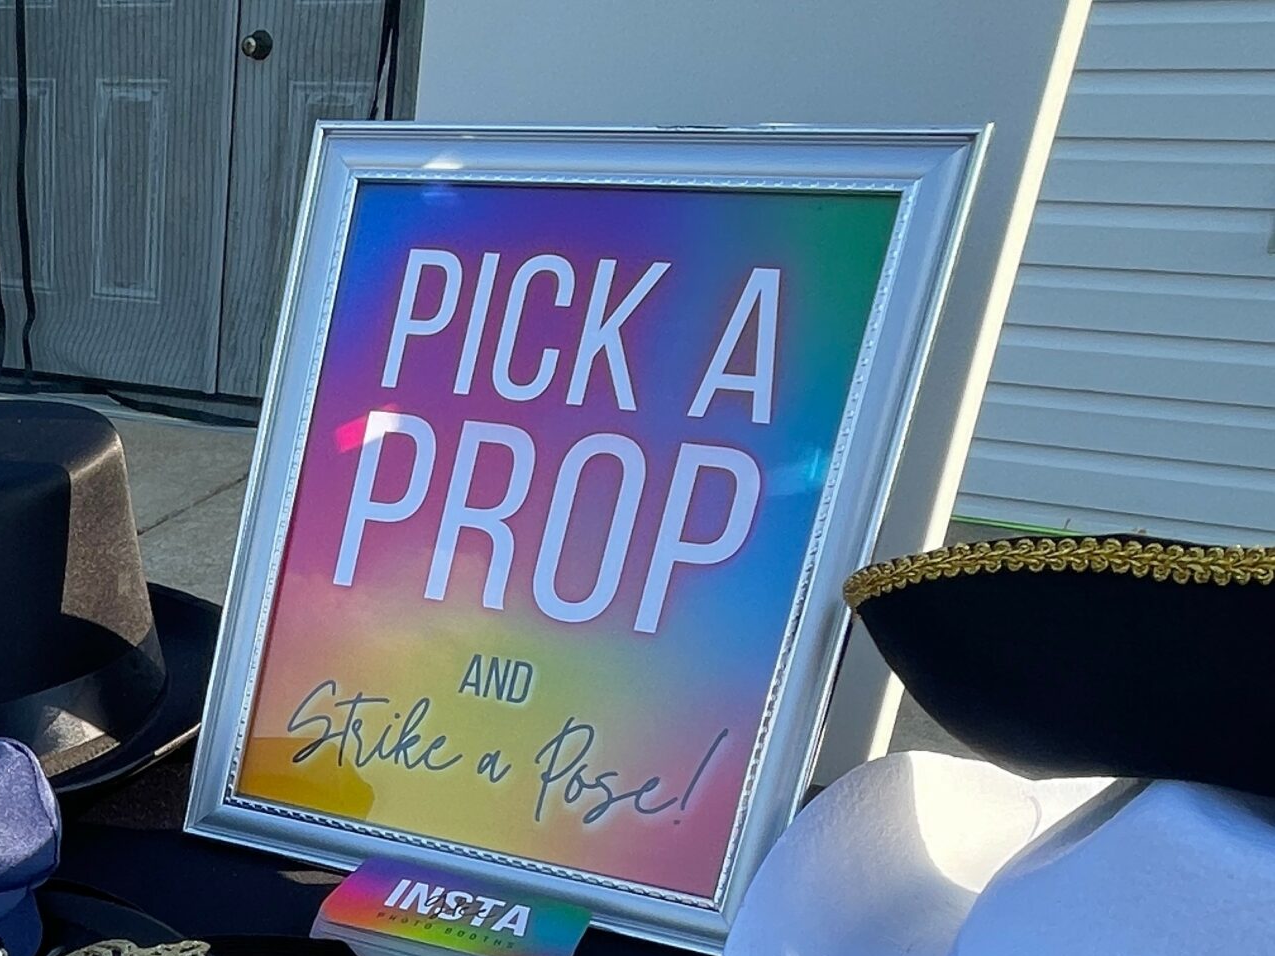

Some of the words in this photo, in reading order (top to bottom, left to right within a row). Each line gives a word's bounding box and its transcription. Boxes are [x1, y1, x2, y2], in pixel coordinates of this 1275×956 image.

[381, 248, 672, 411] PICK
[687, 267, 781, 425] A
[332, 410, 762, 634] PROP
[457, 653, 534, 704] AND
[287, 679, 463, 770] Strike
[476, 748, 512, 783] a
[534, 716, 729, 825] Pose!
[375, 911, 433, 930] PHOTO
[444, 927, 516, 949] BOOTHS
[383, 878, 532, 937] INSTA
